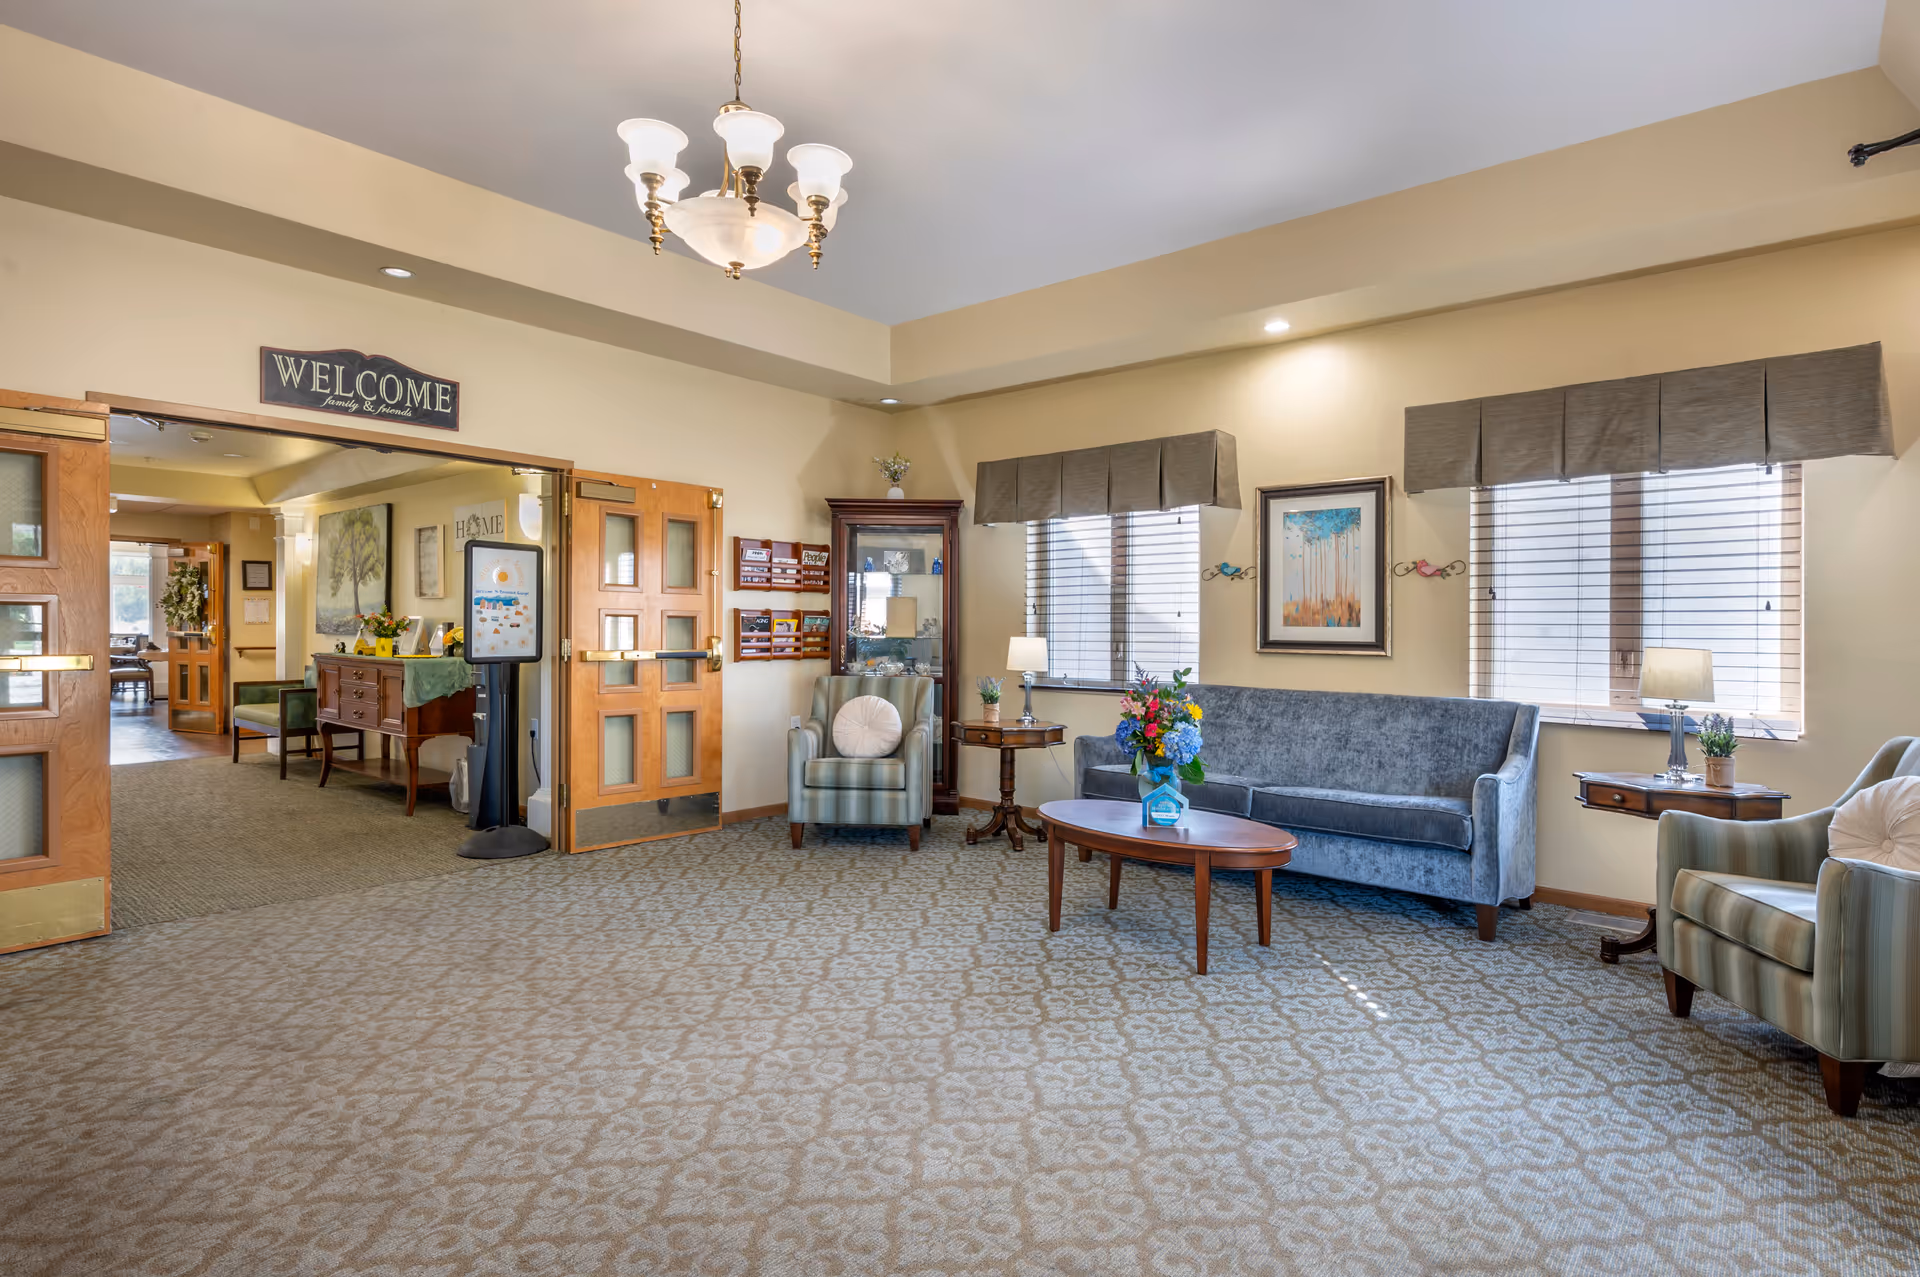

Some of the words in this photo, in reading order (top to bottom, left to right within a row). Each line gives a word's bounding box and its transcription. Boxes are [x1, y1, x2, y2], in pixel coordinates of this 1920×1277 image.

[272, 353, 452, 413] WELCOME
[320, 395, 360, 413] family
[363, 400, 374, 412] &
[373, 403, 412, 417] friends
[803, 551, 827, 563] People
